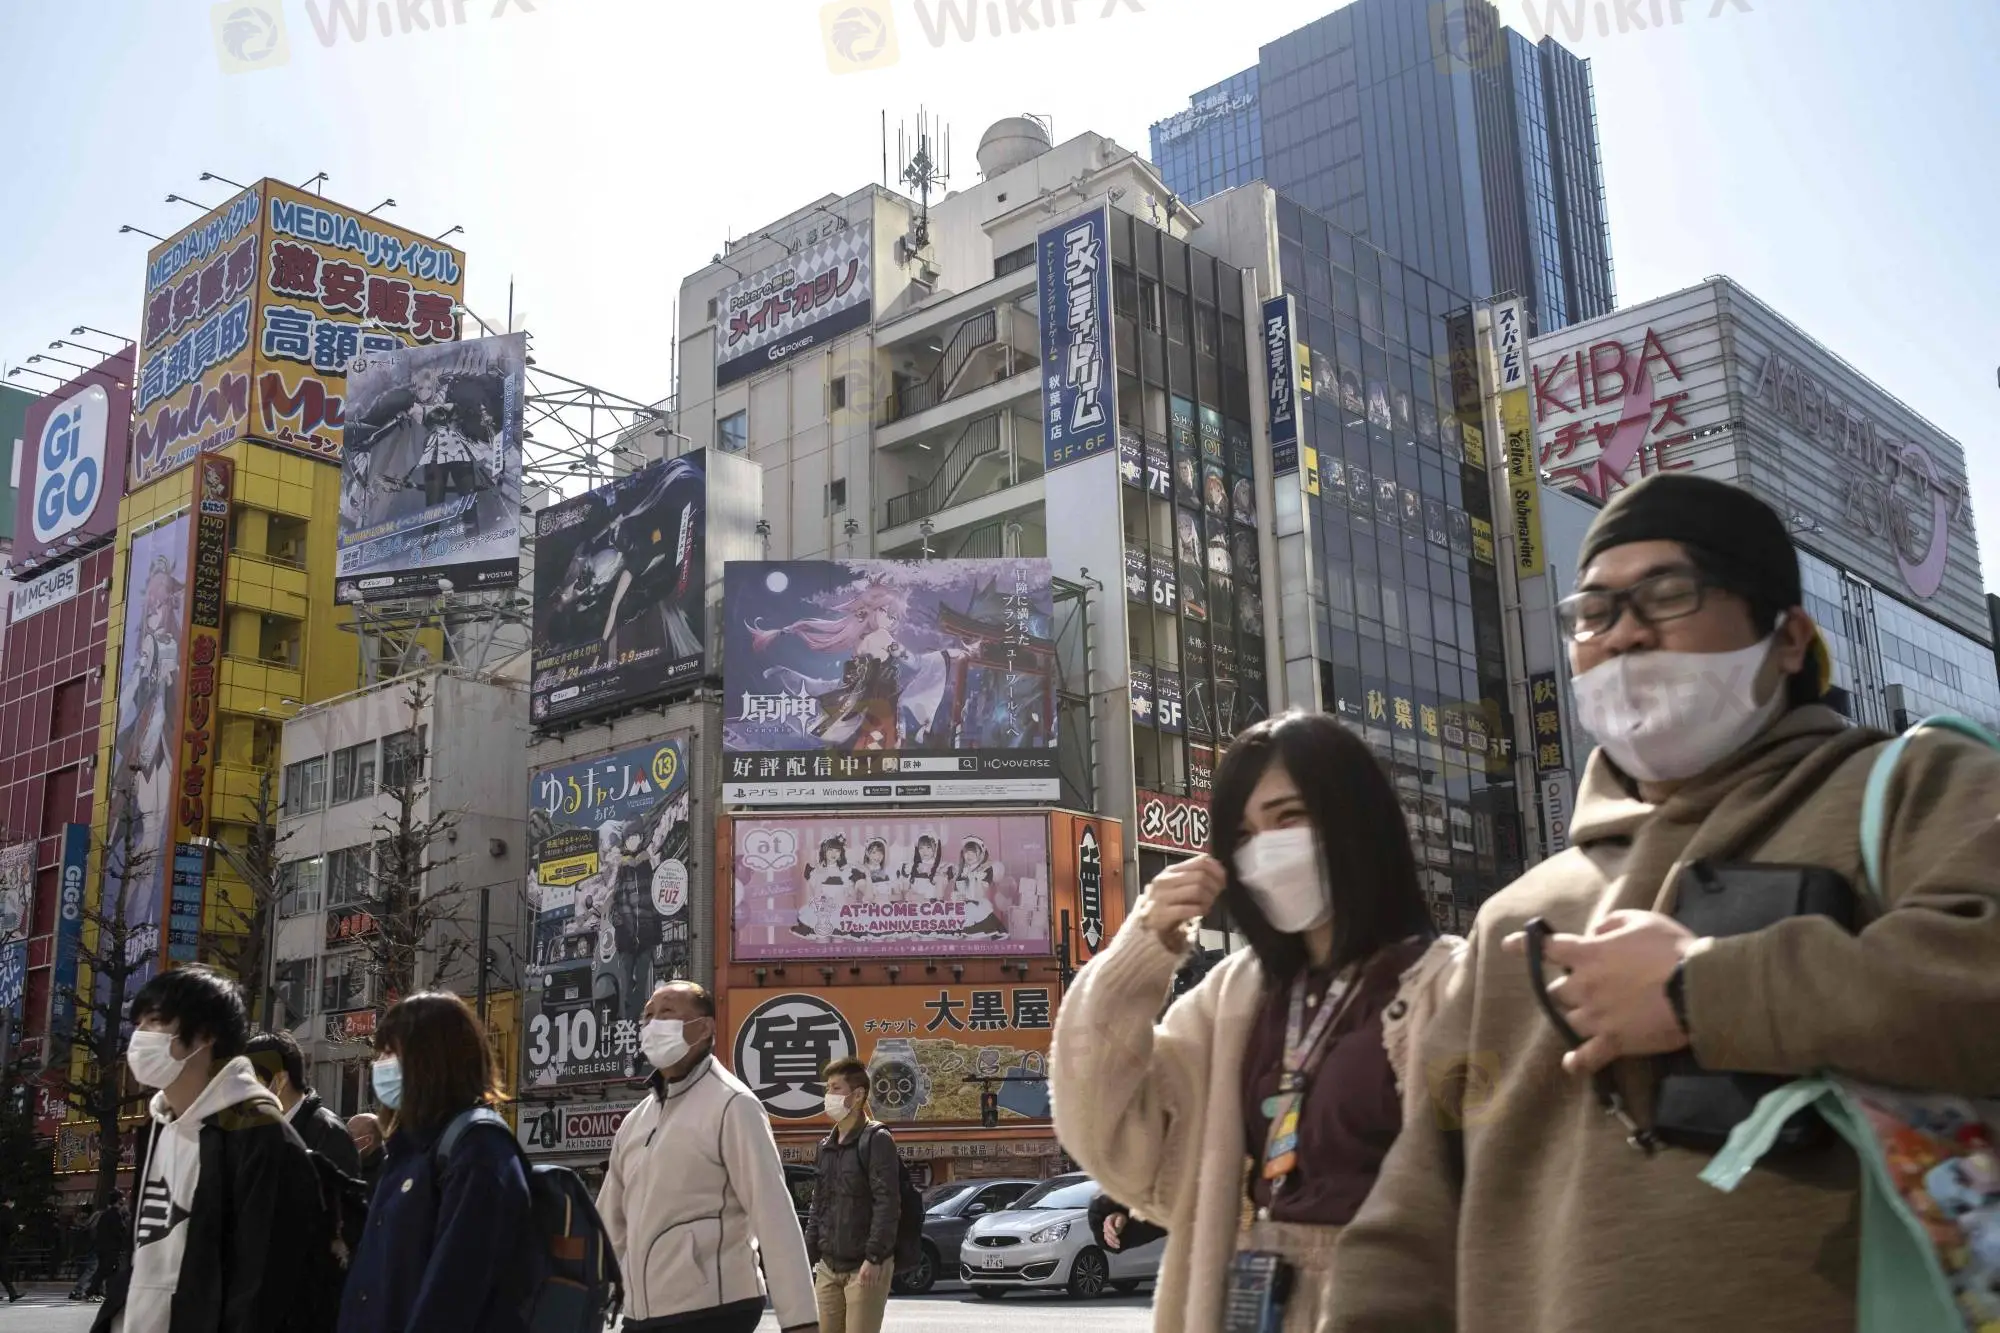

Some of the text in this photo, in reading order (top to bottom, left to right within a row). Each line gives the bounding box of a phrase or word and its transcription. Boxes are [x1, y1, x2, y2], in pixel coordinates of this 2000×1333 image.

[148, 189, 259, 294] MEDIAリサイクル
[270, 197, 461, 283] MEDIAリサイクル
[144, 234, 256, 348] 激安販売
[267, 240, 455, 342] 激安販売
[729, 258, 859, 346] メイドカジノ
[138, 296, 251, 415] 高額買取
[1500, 307, 1520, 383] スーパービル
[1048, 373, 1062, 441] 秋葉原店
[277, 426, 337, 451] ムーラン
[1508, 429, 1523, 477] Yellow
[37, 456, 97, 532] GO
[1147, 466, 1170, 494] 7F
[201, 515, 225, 529] DVD
[1514, 489, 1533, 569] Submarine
[202, 553, 218, 564] CD
[1015, 569, 1030, 647] 冒険に満ちた
[1152, 580, 1176, 606] 6F
[1002, 596, 1020, 737] ブランニューワールドへ
[1159, 699, 1182, 727] 5F
[1367, 689, 1438, 737] 秋葉館
[1533, 680, 1560, 768] 秋葉館
[658, 757, 673, 776] 13
[1191, 774, 1212, 789] Stars
[749, 788, 778, 797] PS5
[786, 787, 815, 797] PS4
[822, 787, 859, 797] Windows
[1141, 799, 1211, 850] メイド
[657, 889, 680, 904] FUZ
[920, 901, 966, 917] CAFE
[869, 918, 966, 932] ANNIVERSARY
[864, 1019, 918, 1034] チケット
[925, 988, 1051, 1033] 大黒屋
[751, 1012, 840, 1095] 質
[568, 1115, 622, 1137] COMIC
